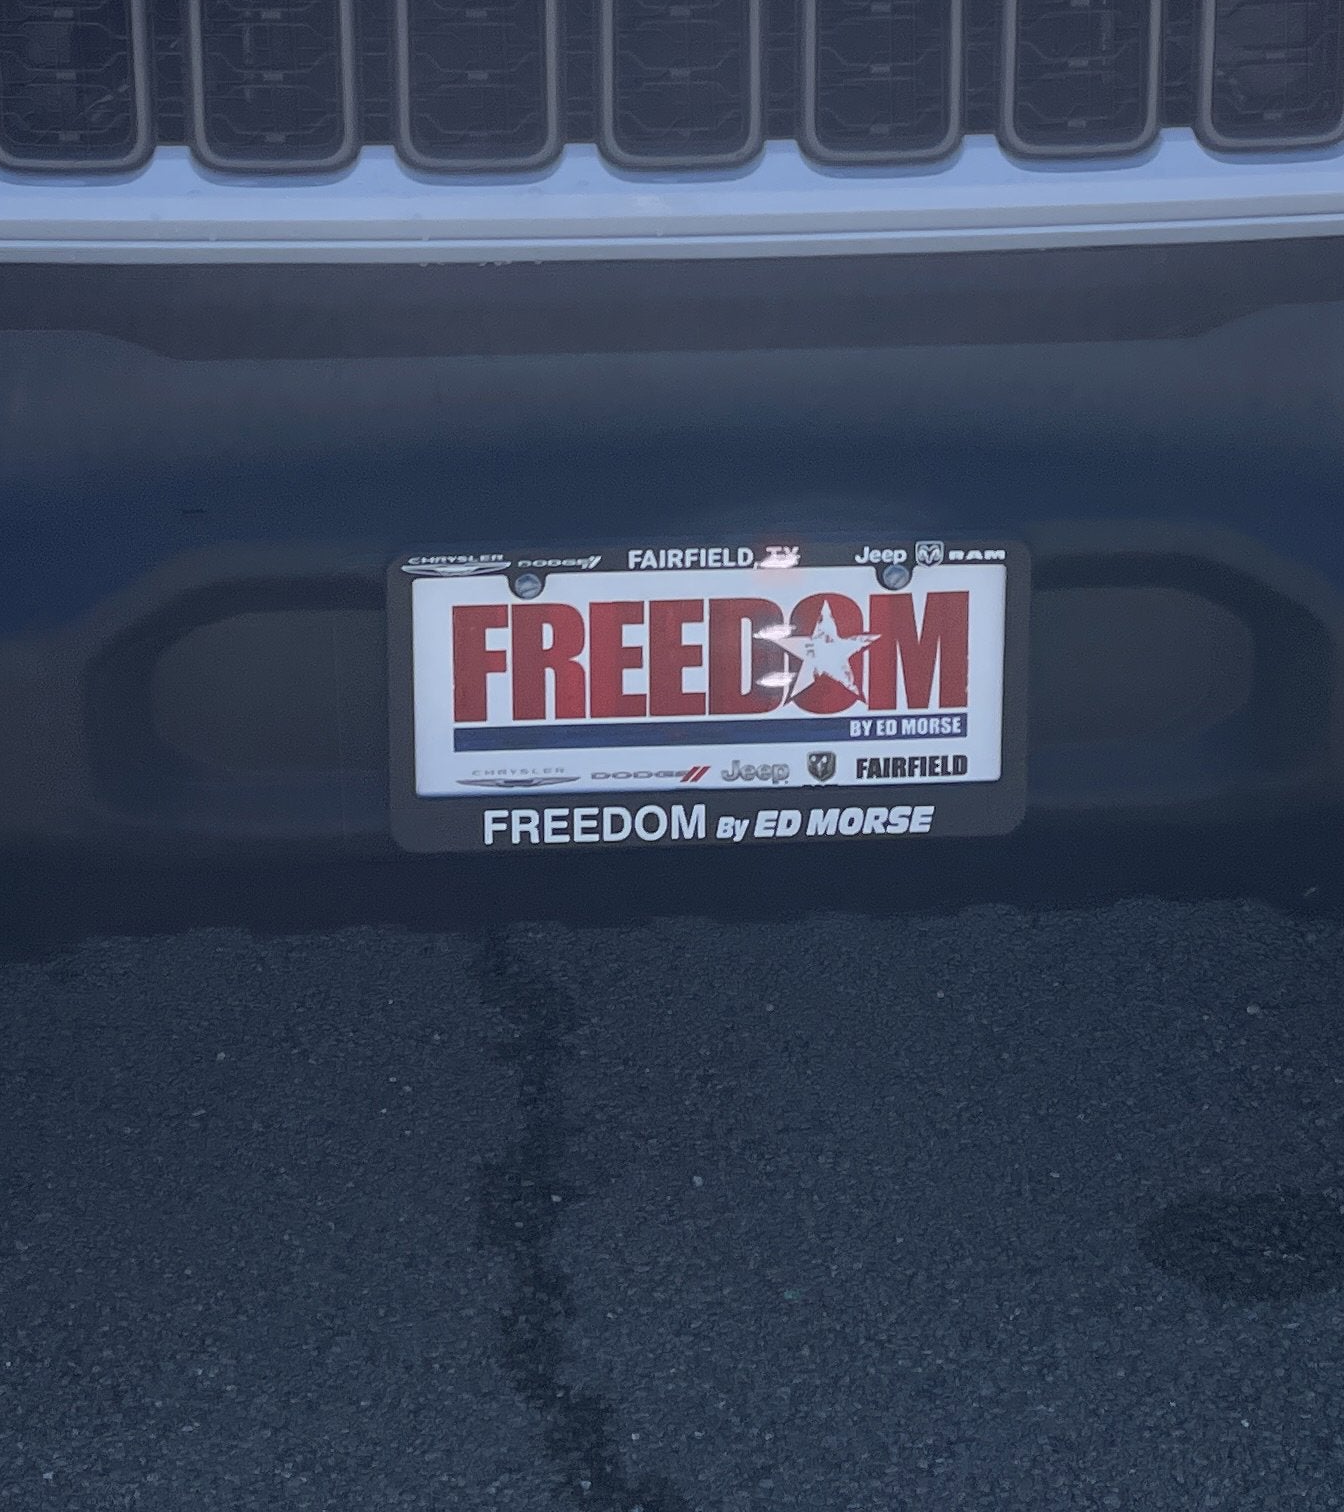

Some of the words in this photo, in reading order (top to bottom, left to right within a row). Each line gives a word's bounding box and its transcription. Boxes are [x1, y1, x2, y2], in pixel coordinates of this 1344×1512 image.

[407, 553, 504, 565] CHRYSLER
[854, 545, 907, 565] Jeep
[948, 549, 1006, 561] RAM
[452, 590, 970, 722] FREEDOM
[849, 719, 872, 738] BY
[876, 718, 897, 736] ED
[901, 716, 961, 735] MORSE
[471, 767, 566, 776] CHRYSLER
[720, 759, 791, 784] Jeep
[855, 754, 968, 780] FAIRFIELD
[482, 803, 706, 846] FREEDOM
[716, 816, 749, 843] By
[754, 809, 801, 839] ED
[805, 805, 936, 838] MORSE
